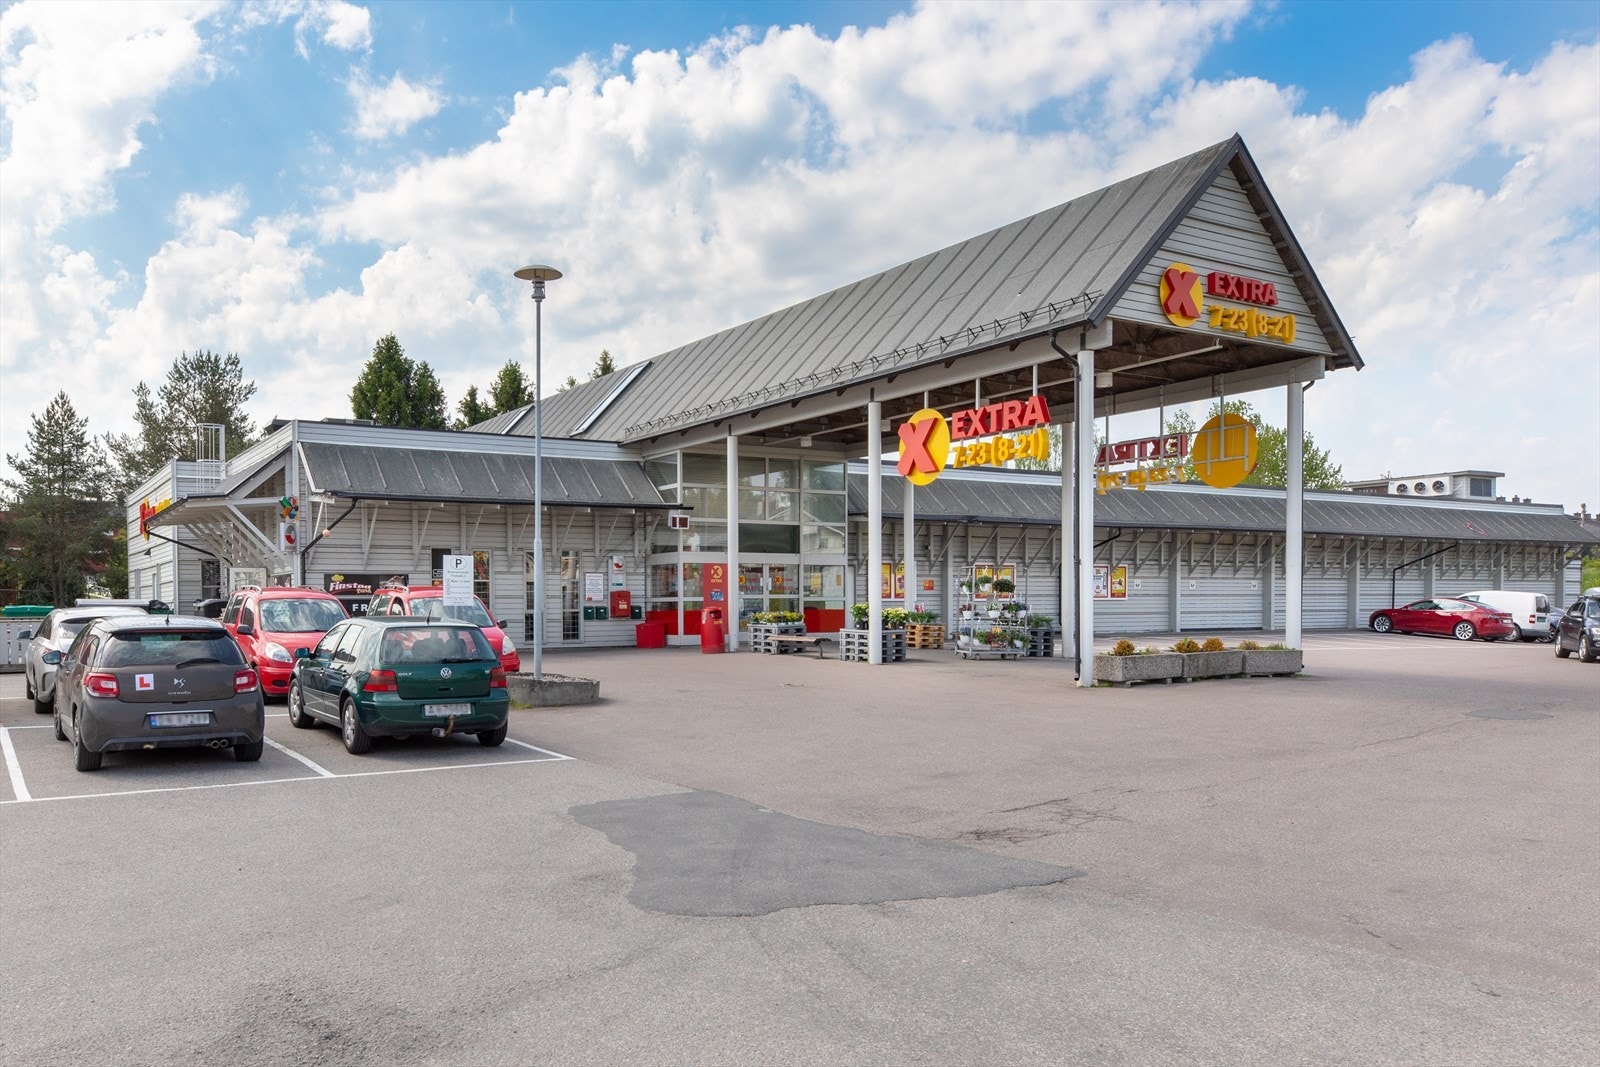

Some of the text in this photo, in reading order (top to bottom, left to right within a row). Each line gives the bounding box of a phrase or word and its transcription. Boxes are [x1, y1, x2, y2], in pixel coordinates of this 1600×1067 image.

[1207, 271, 1279, 306] EXTRA
[951, 395, 1052, 440] EXTRA
[455, 558, 463, 569] P
[139, 677, 150, 688] L
